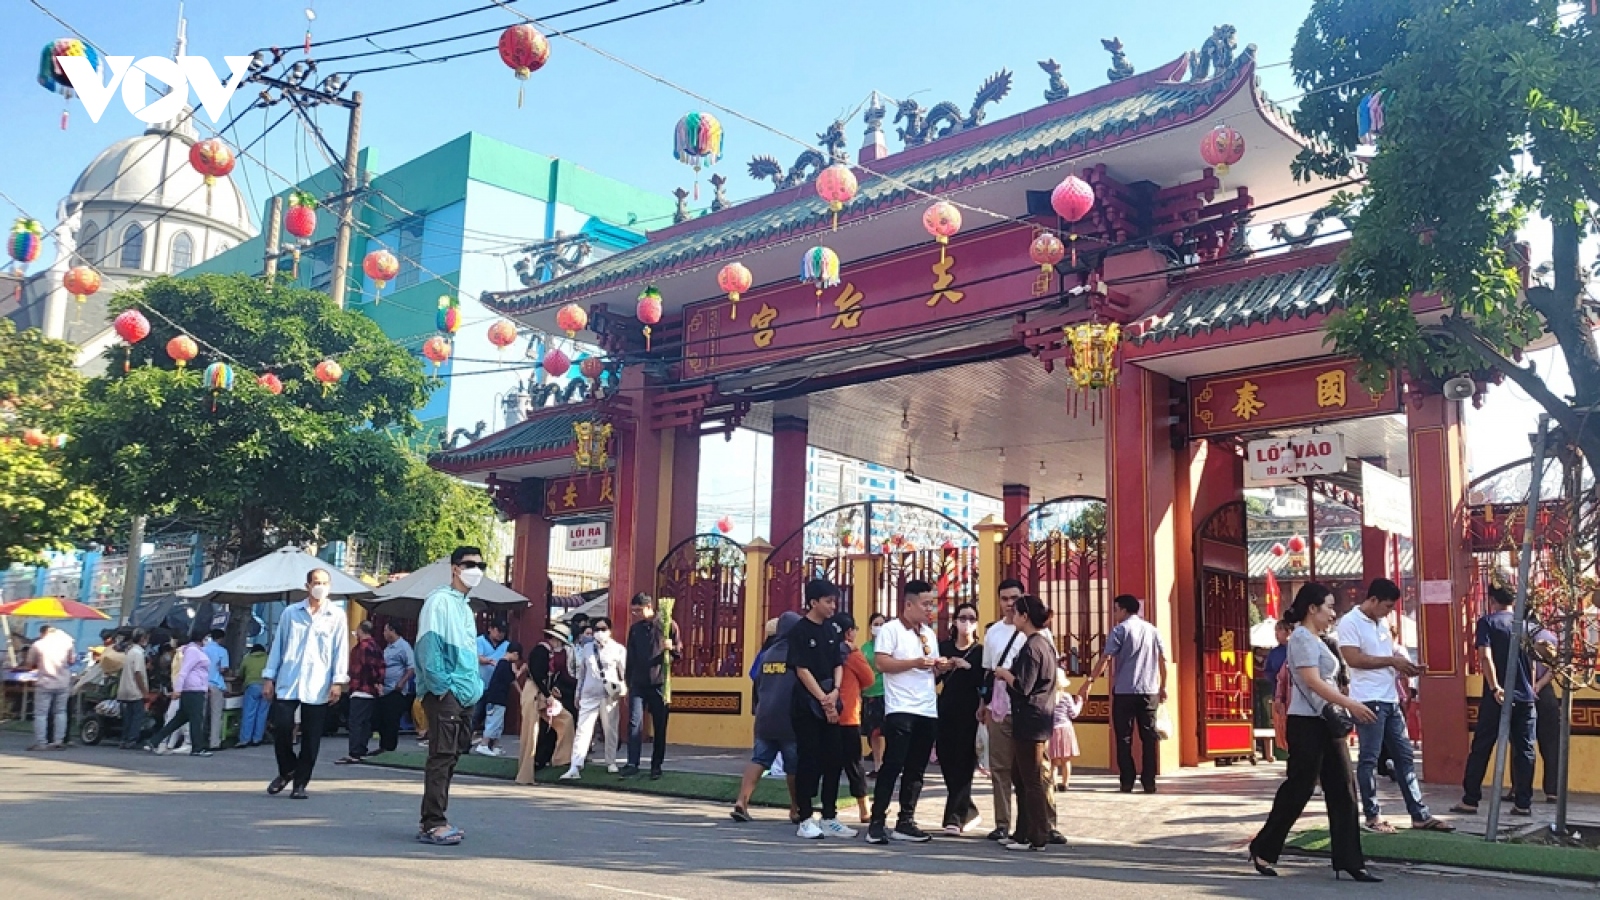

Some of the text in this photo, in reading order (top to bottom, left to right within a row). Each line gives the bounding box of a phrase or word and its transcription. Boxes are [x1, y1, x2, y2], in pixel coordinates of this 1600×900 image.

[1292, 440, 1332, 459] VÀO
[570, 526, 601, 539] LỐI RA
